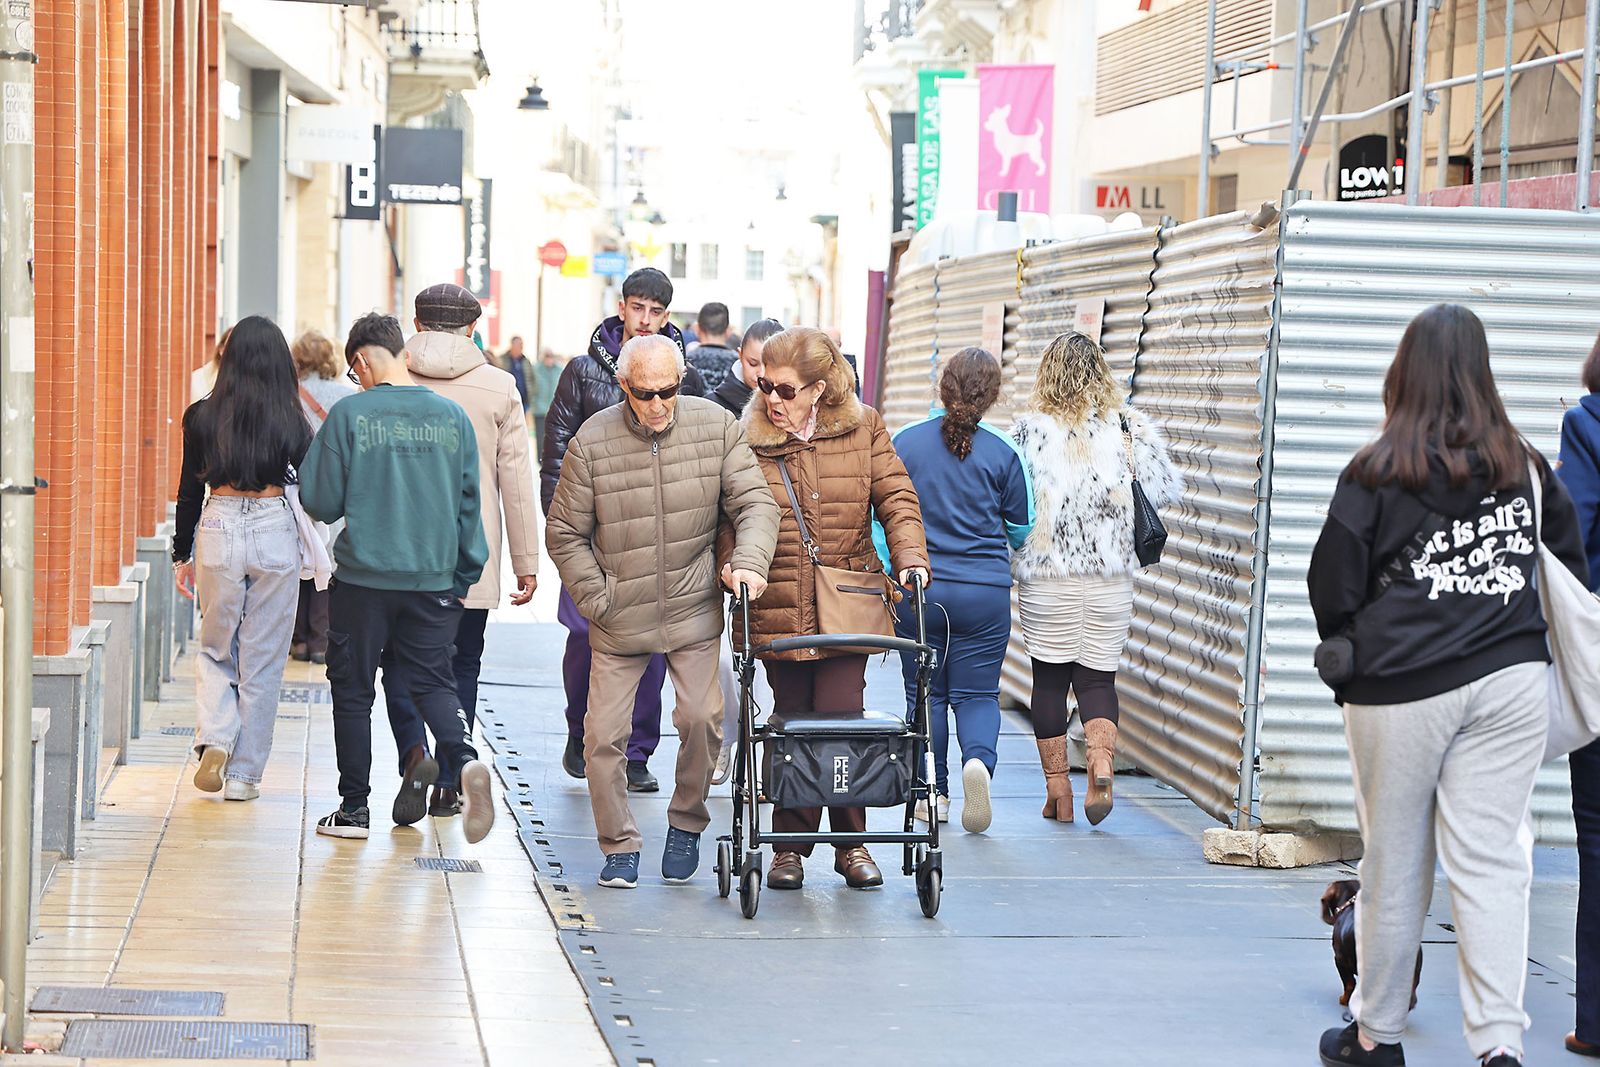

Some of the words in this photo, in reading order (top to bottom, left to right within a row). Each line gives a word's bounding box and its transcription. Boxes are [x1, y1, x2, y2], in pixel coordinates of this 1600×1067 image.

[922, 140, 939, 169] DE
[920, 171, 939, 224] CASA
[1451, 519, 1475, 548] is
[1477, 504, 1519, 537] all
[1410, 554, 1467, 580] part
[1468, 536, 1498, 567] of
[1427, 565, 1526, 603] process
